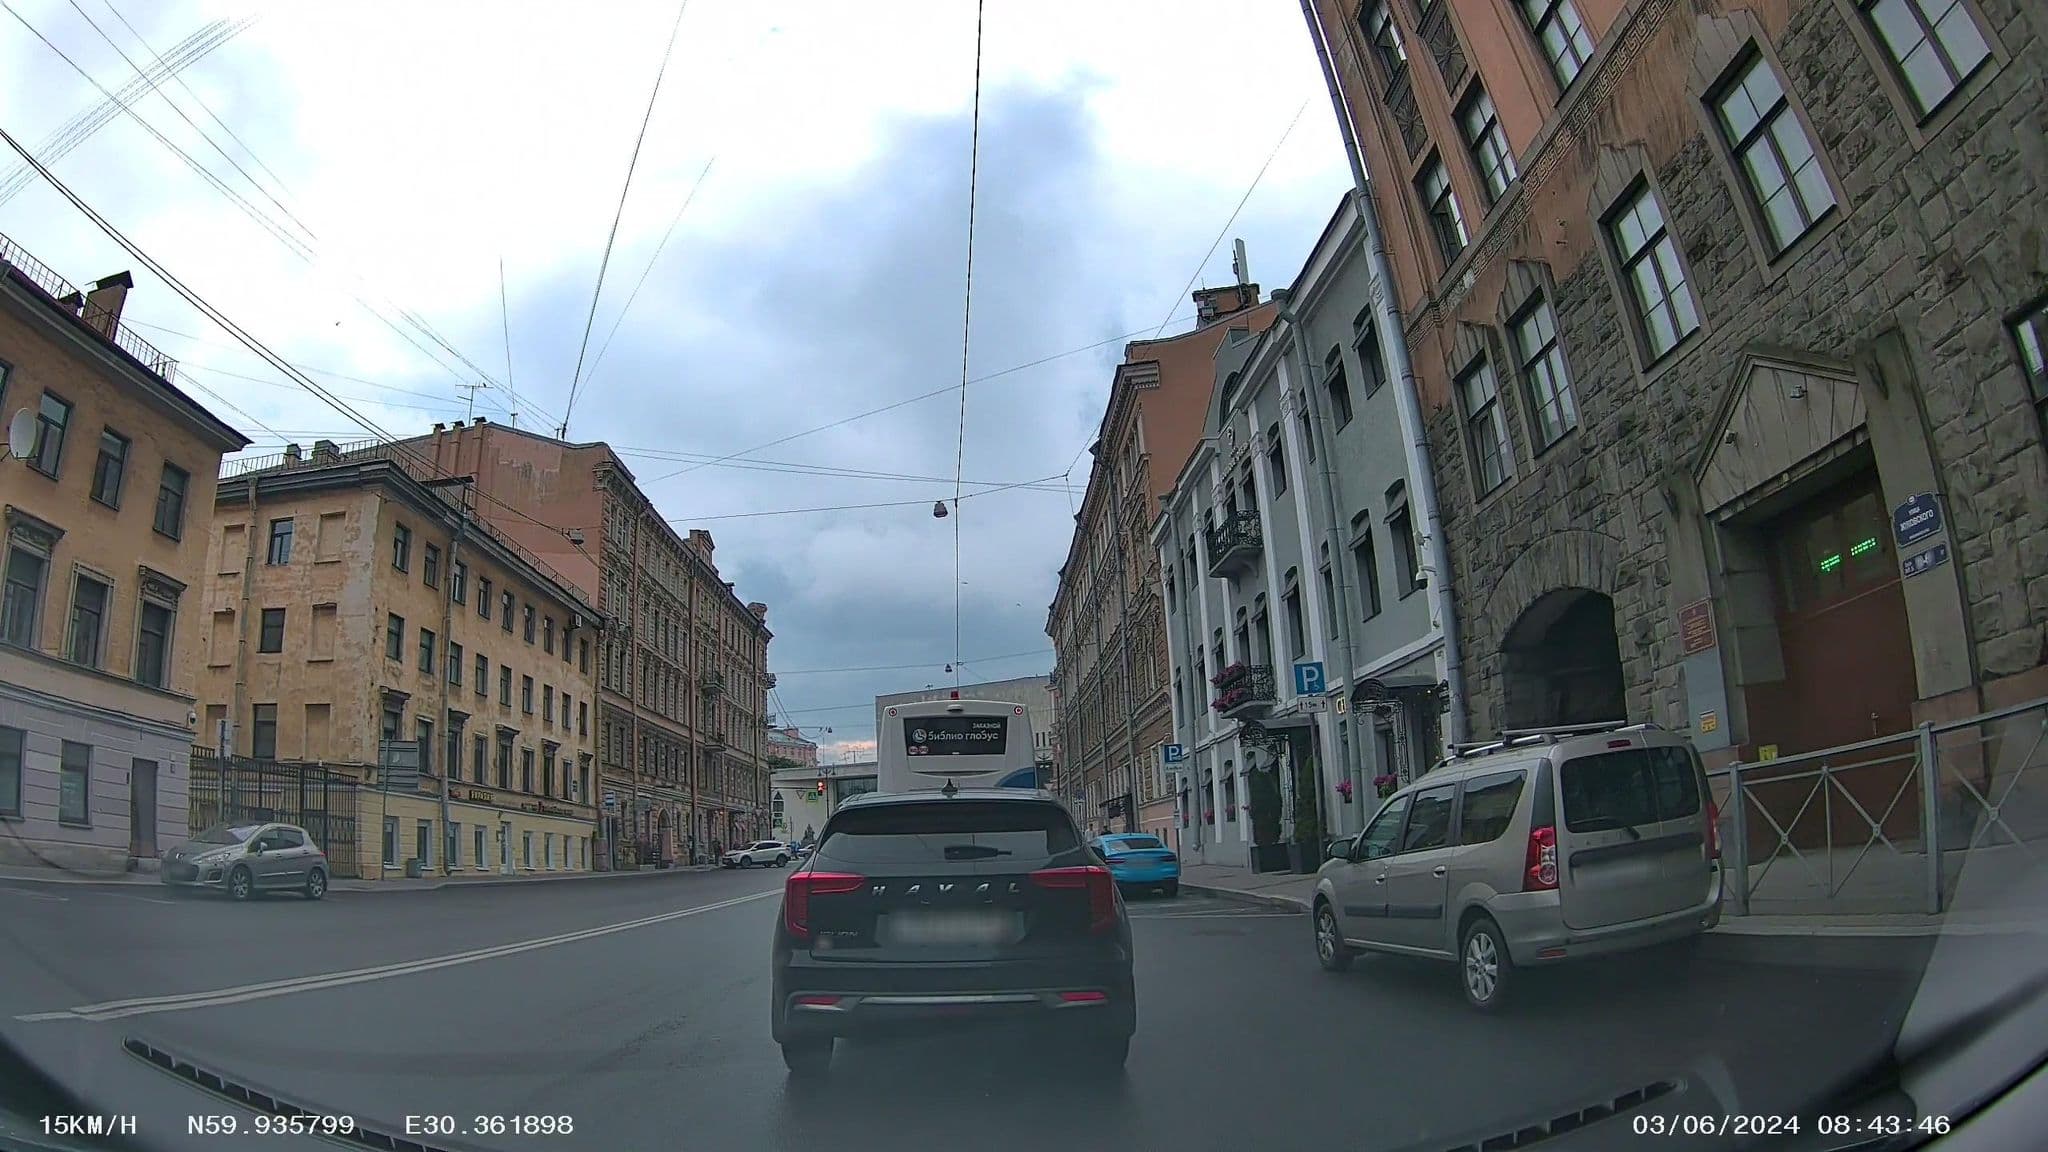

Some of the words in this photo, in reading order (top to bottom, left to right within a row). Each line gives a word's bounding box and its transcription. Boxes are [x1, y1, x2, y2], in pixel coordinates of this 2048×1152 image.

[1302, 666, 1319, 691] P
[927, 730, 963, 740] библио
[965, 730, 999, 742] глобус
[1168, 746, 1180, 761] P
[871, 882, 1021, 896] HAVAL
